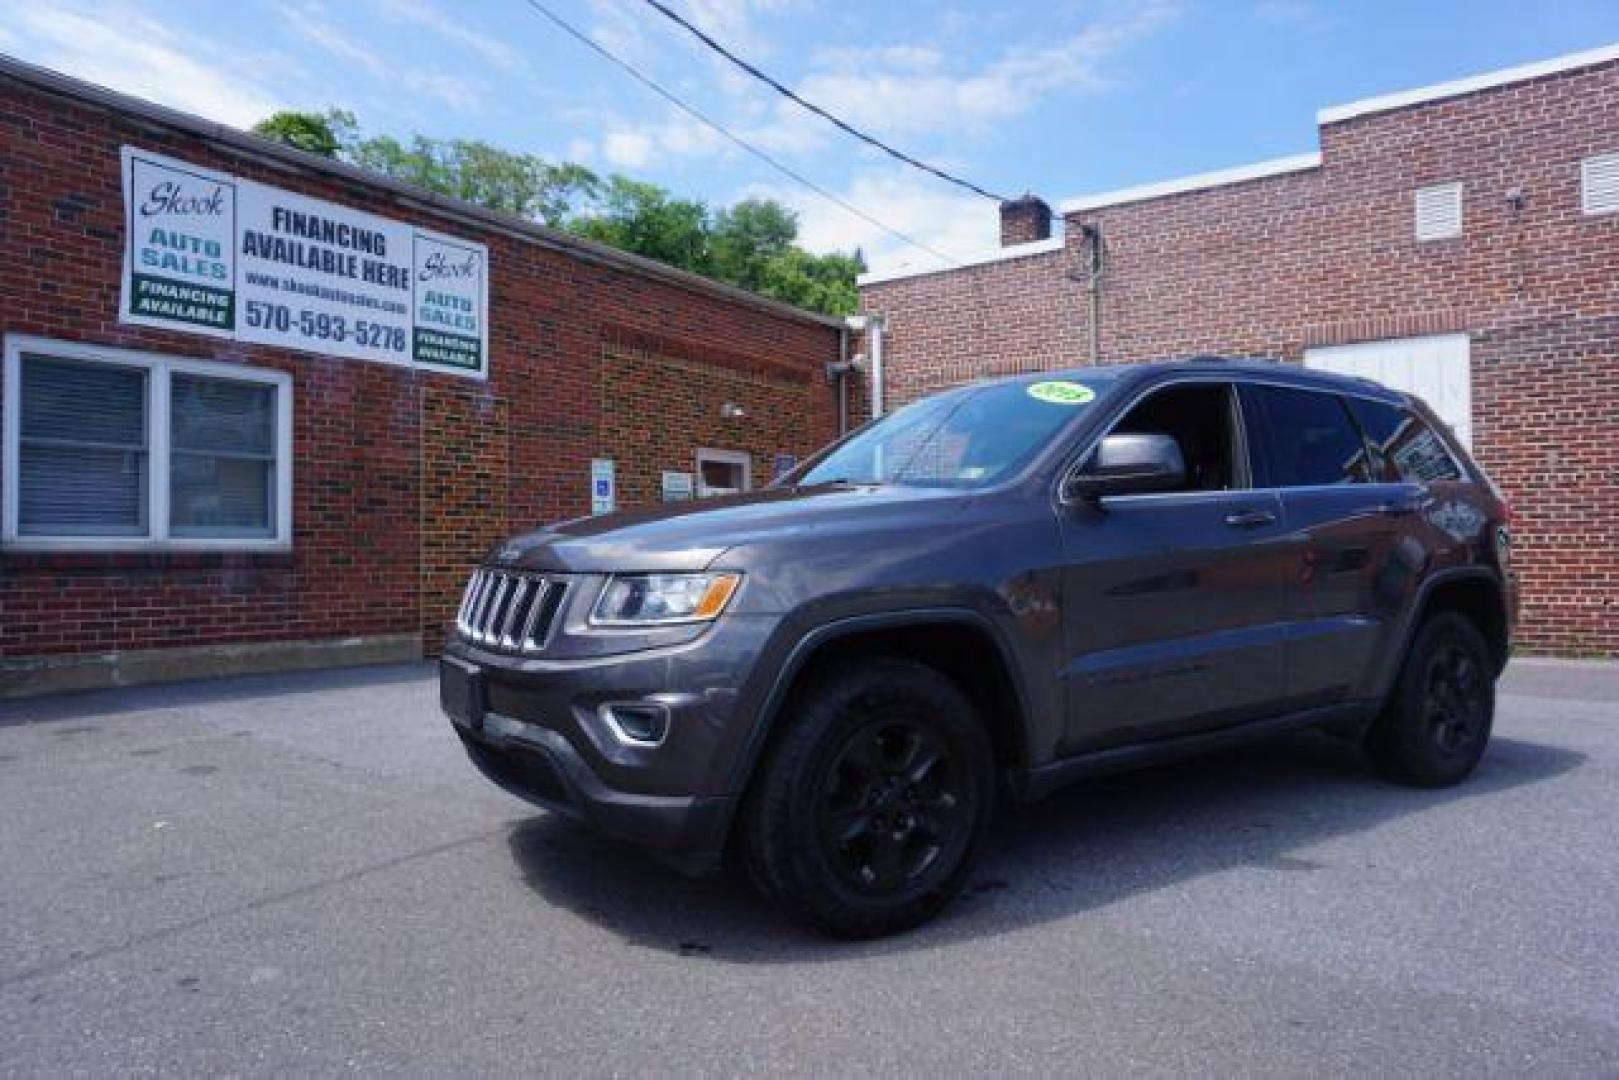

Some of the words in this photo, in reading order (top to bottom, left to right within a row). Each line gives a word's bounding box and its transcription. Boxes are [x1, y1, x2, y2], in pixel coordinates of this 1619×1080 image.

[149, 228, 221, 258] AUTO
[273, 207, 385, 256] FINANCING
[141, 248, 227, 279] SALES
[243, 230, 357, 278] AVAILABLE
[362, 259, 408, 290] HERE
[140, 280, 228, 306] FINANCING
[425, 290, 471, 312] AUTO
[139, 298, 226, 322] AVAILABLE
